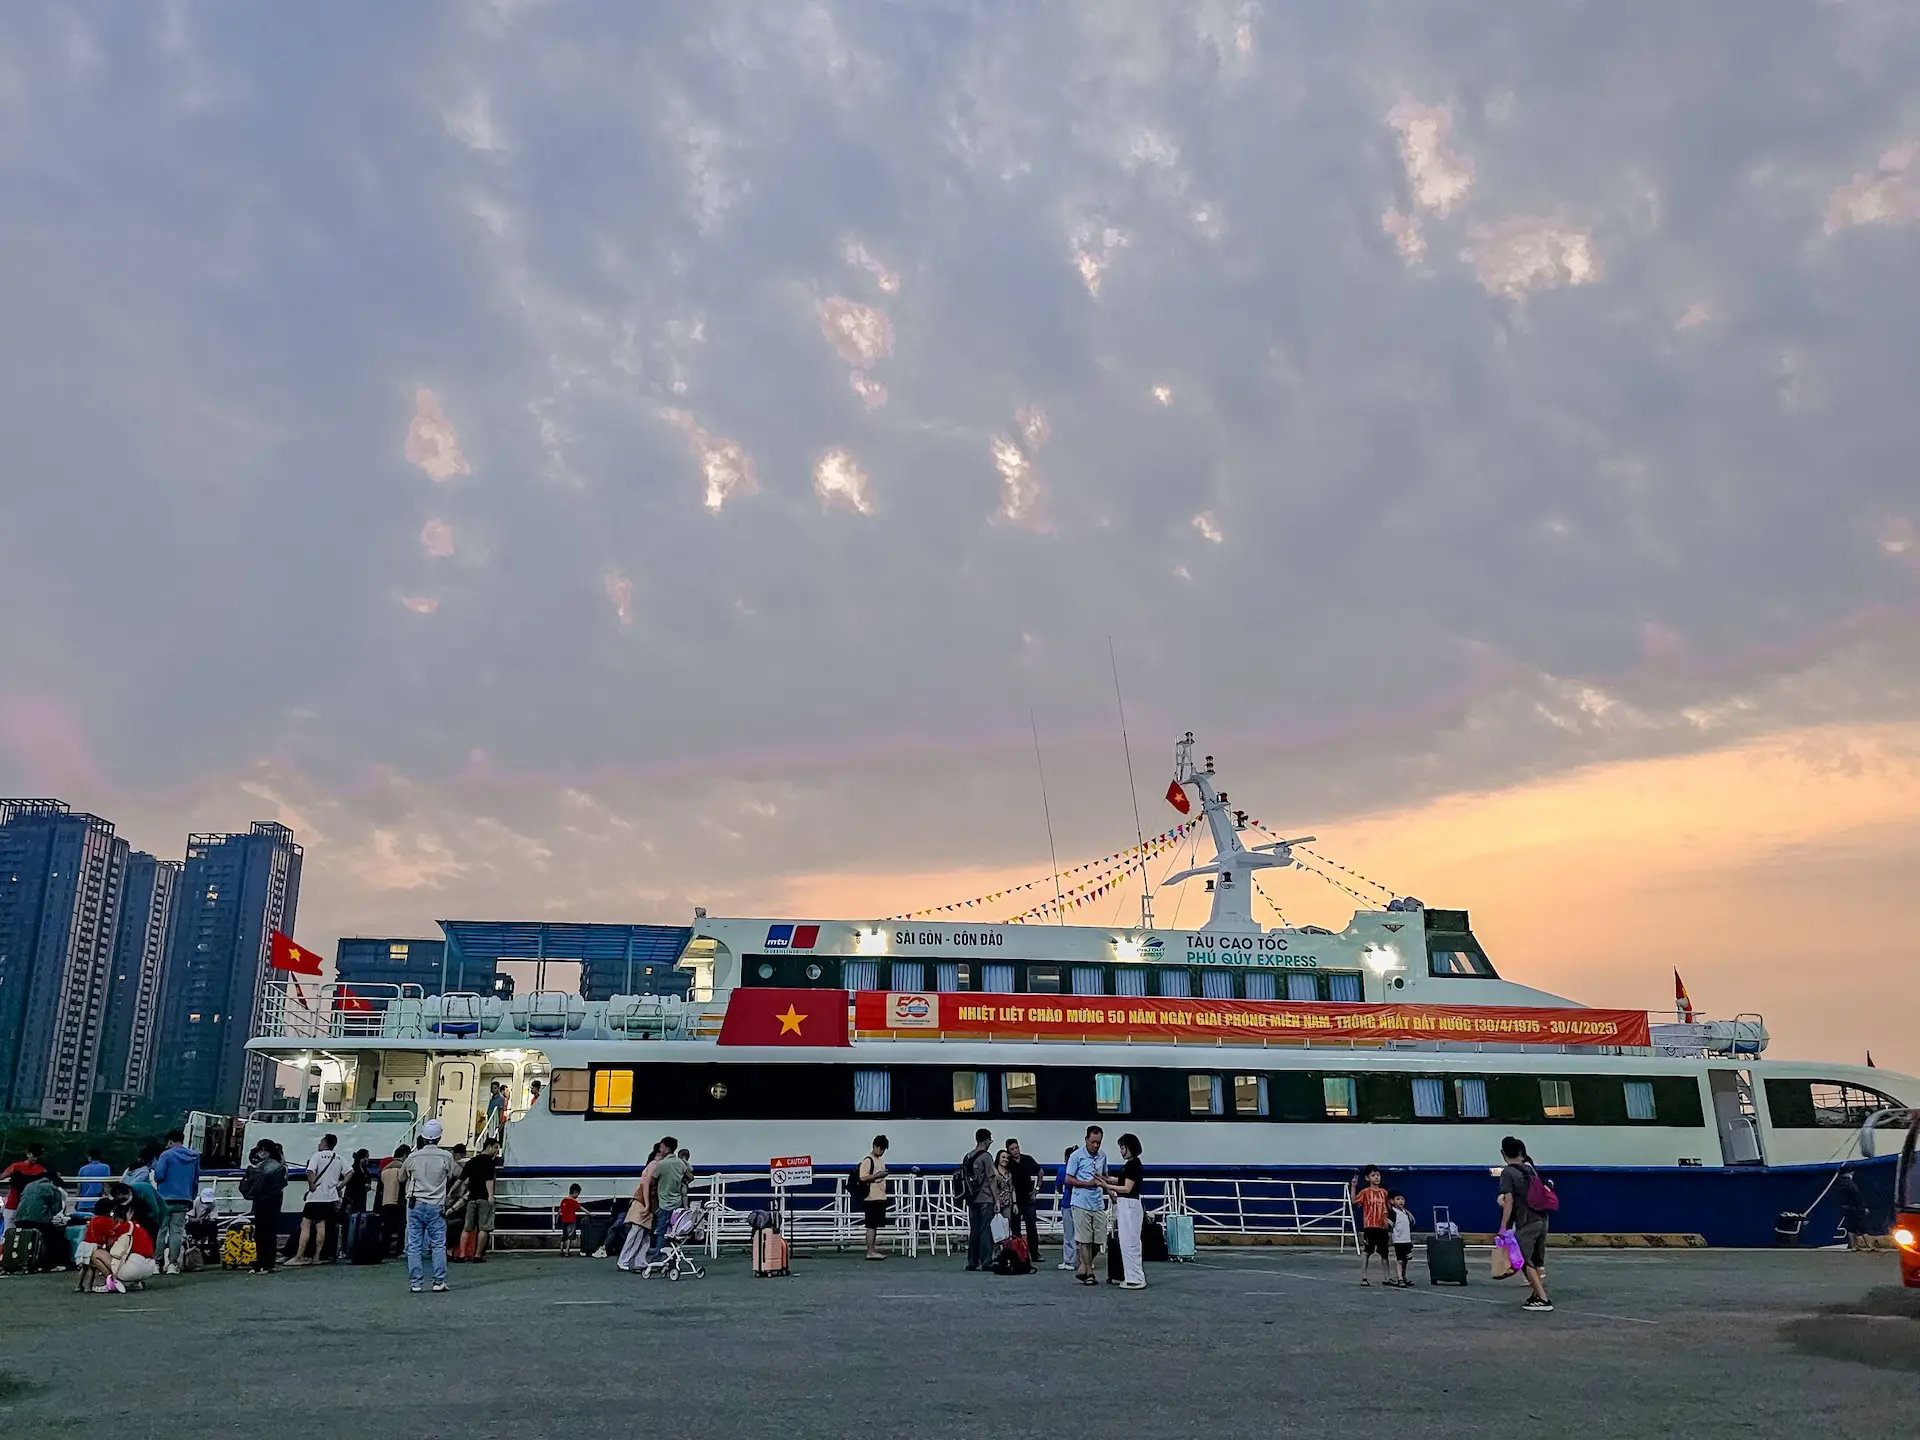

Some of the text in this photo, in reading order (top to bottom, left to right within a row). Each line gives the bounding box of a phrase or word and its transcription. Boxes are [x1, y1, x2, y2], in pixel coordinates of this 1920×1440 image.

[766, 938, 788, 946] mtu
[895, 929, 915, 945] SÀI
[919, 929, 942, 945] GÒN
[953, 930, 977, 946] CÔN
[980, 929, 1003, 946] ĐẢO
[1186, 932, 1288, 951] TÀU CAO TỐC
[1186, 949, 1217, 964] PHÚ
[1257, 953, 1317, 968] EXPRESS
[958, 1004, 996, 1023] NHIỆT
[999, 1005, 1025, 1024] LIỆT
[1028, 1007, 1063, 1023] CHÀO
[1066, 1008, 1105, 1024] MỪNG
[1108, 1010, 1125, 1024] 50
[1128, 1008, 1157, 1025] NĂM
[1160, 1009, 1193, 1026] NGÀY
[1225, 1011, 1268, 1027] PHÓNG
[1413, 1012, 1436, 1030] ĐẤT
[1439, 1014, 1472, 1031] NƯỚC
[1474, 1018, 1541, 1033] (30/4/1975
[1550, 1020, 1618, 1035] 30/4/2025)
[786, 1157, 809, 1165] CAUTION
